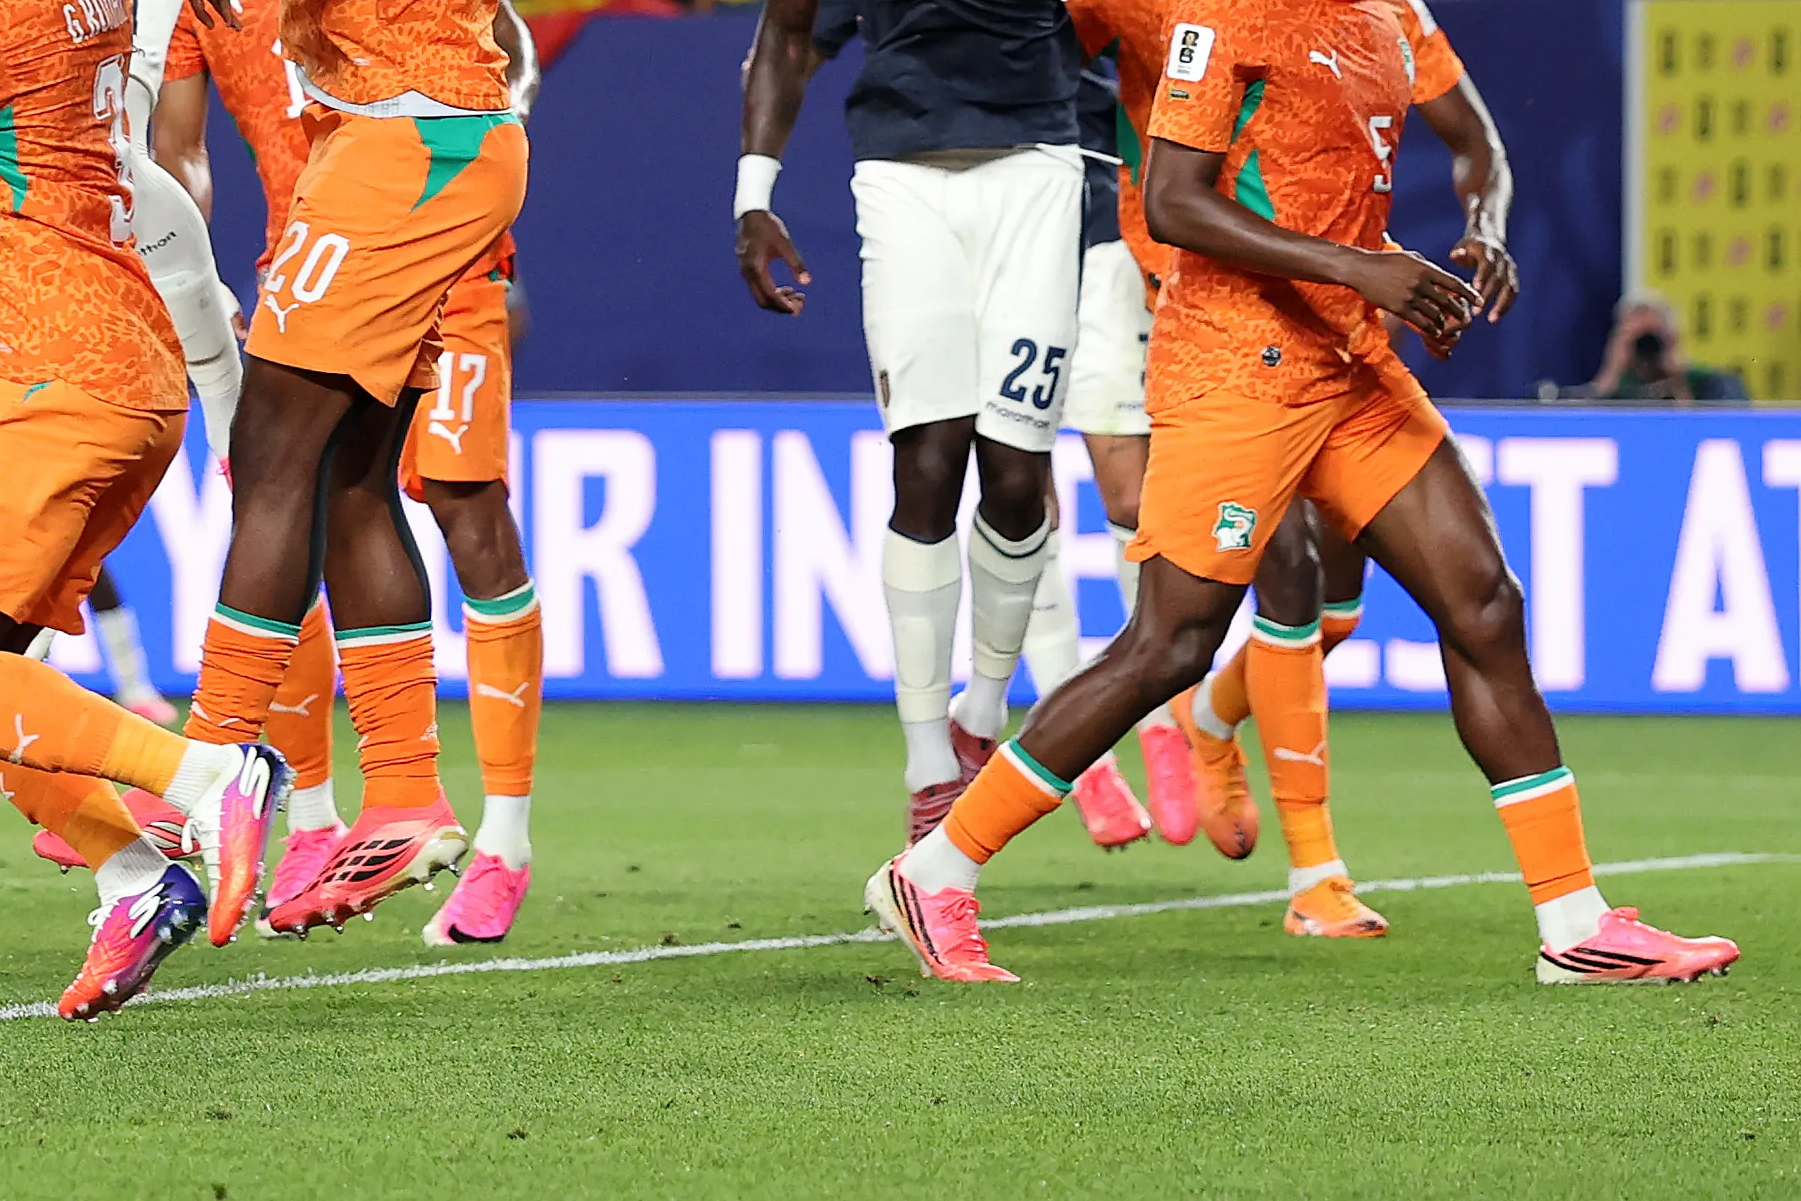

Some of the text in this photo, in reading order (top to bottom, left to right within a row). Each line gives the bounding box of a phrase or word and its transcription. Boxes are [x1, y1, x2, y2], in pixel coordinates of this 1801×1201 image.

[1368, 115, 1393, 193] 5
[263, 221, 350, 303] 20
[429, 351, 487, 422] 17
[1000, 338, 1066, 410] 25
